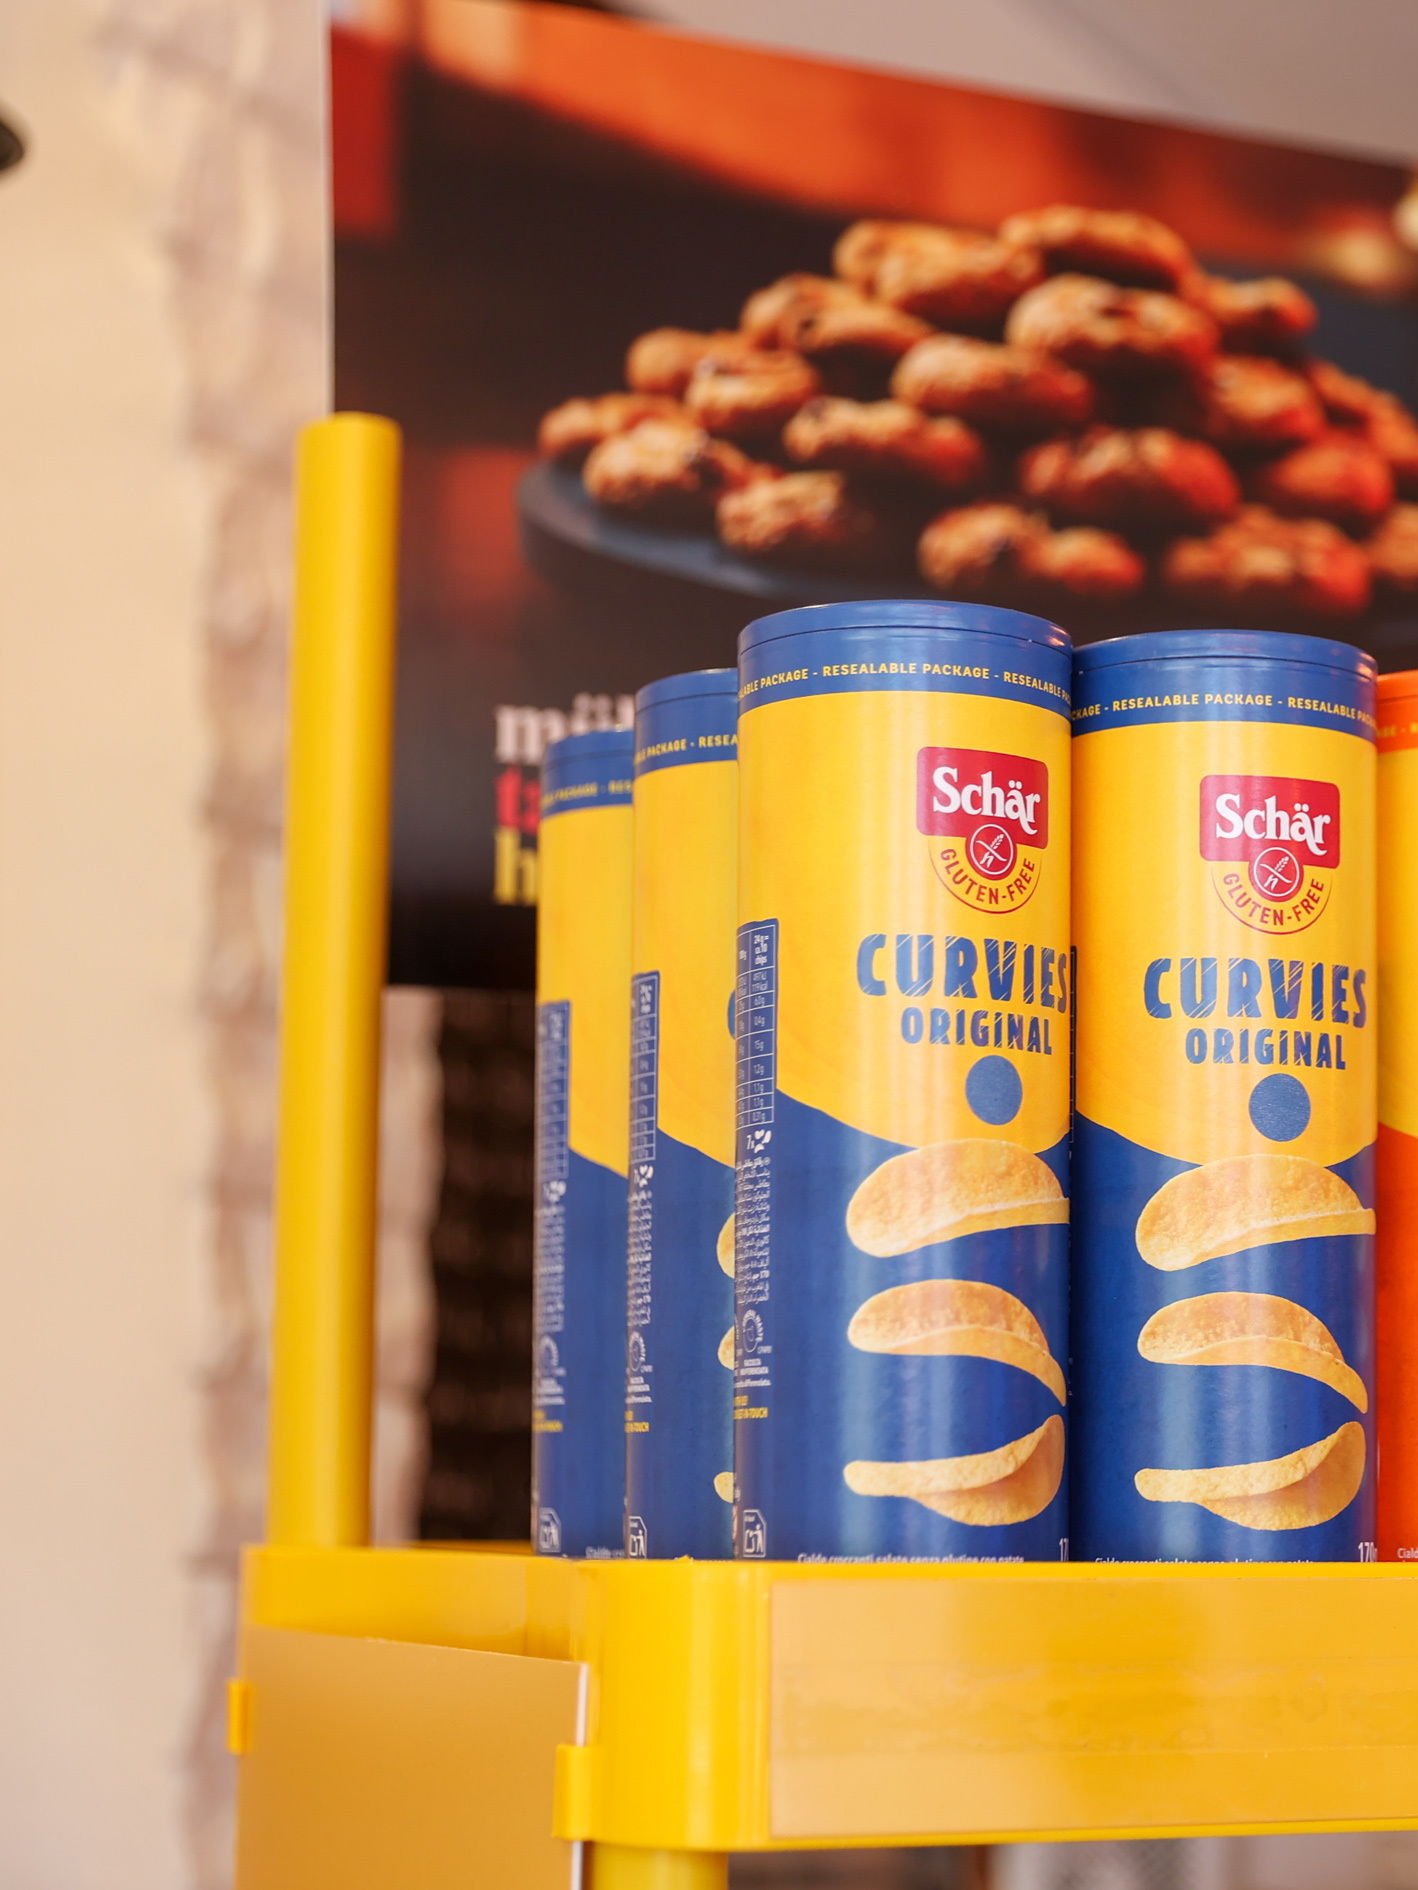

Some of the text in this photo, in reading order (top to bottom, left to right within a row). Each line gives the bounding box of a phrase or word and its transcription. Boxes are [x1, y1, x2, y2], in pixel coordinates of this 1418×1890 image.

[760, 668, 809, 689] PACKAGE
[822, 662, 917, 677] RESEALABLE
[922, 663, 990, 679] PACKAGE
[1003, 671, 1062, 698] RESEALABLE
[1071, 703, 1101, 721] CKAGE
[1112, 694, 1200, 712] RESEALABLE
[1205, 693, 1273, 706] PACKAGE
[1288, 697, 1356, 720] RESEALABLE
[699, 734, 738, 748] RESEA
[932, 766, 1041, 834] Schär
[1215, 793, 1330, 855] Schär
[940, 848, 1036, 905] GLUTEN-FREE
[1223, 872, 1325, 926] GLUTEN-FREE
[856, 934, 1069, 1014] CURVIES
[1143, 957, 1367, 1029] CURVIES
